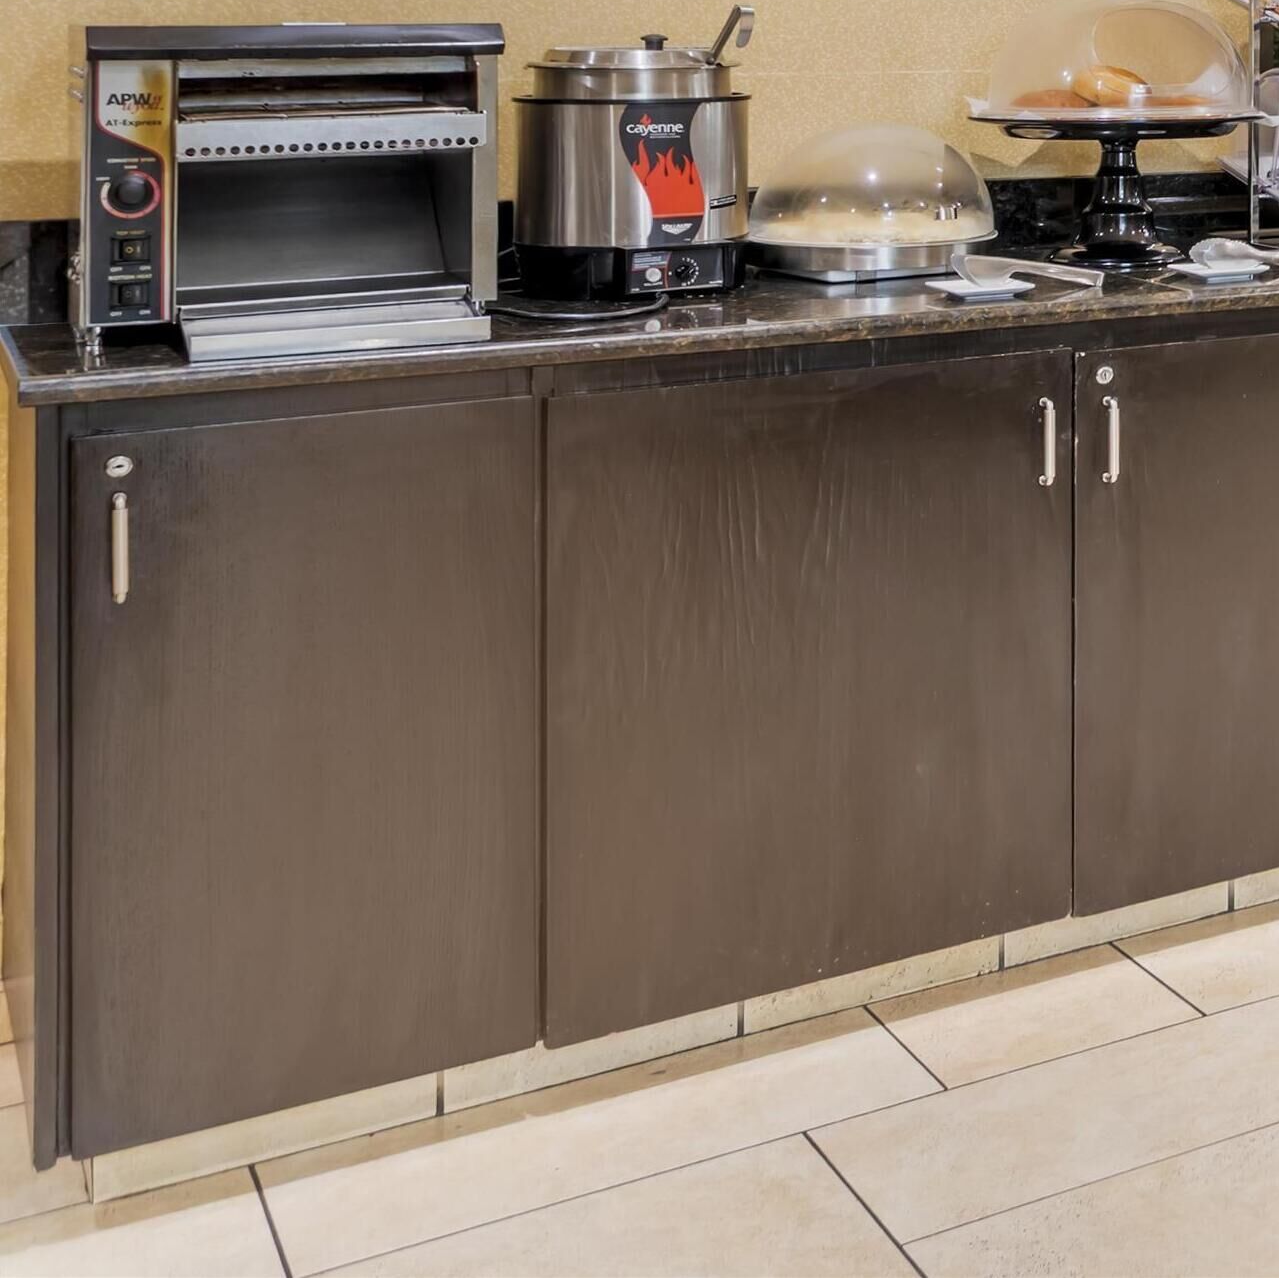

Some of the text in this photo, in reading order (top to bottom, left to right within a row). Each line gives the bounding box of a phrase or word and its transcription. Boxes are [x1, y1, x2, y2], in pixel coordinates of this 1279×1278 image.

[106, 93, 152, 105] APW
[105, 119, 162, 128] AT-Express
[626, 122, 684, 138] cayenne
